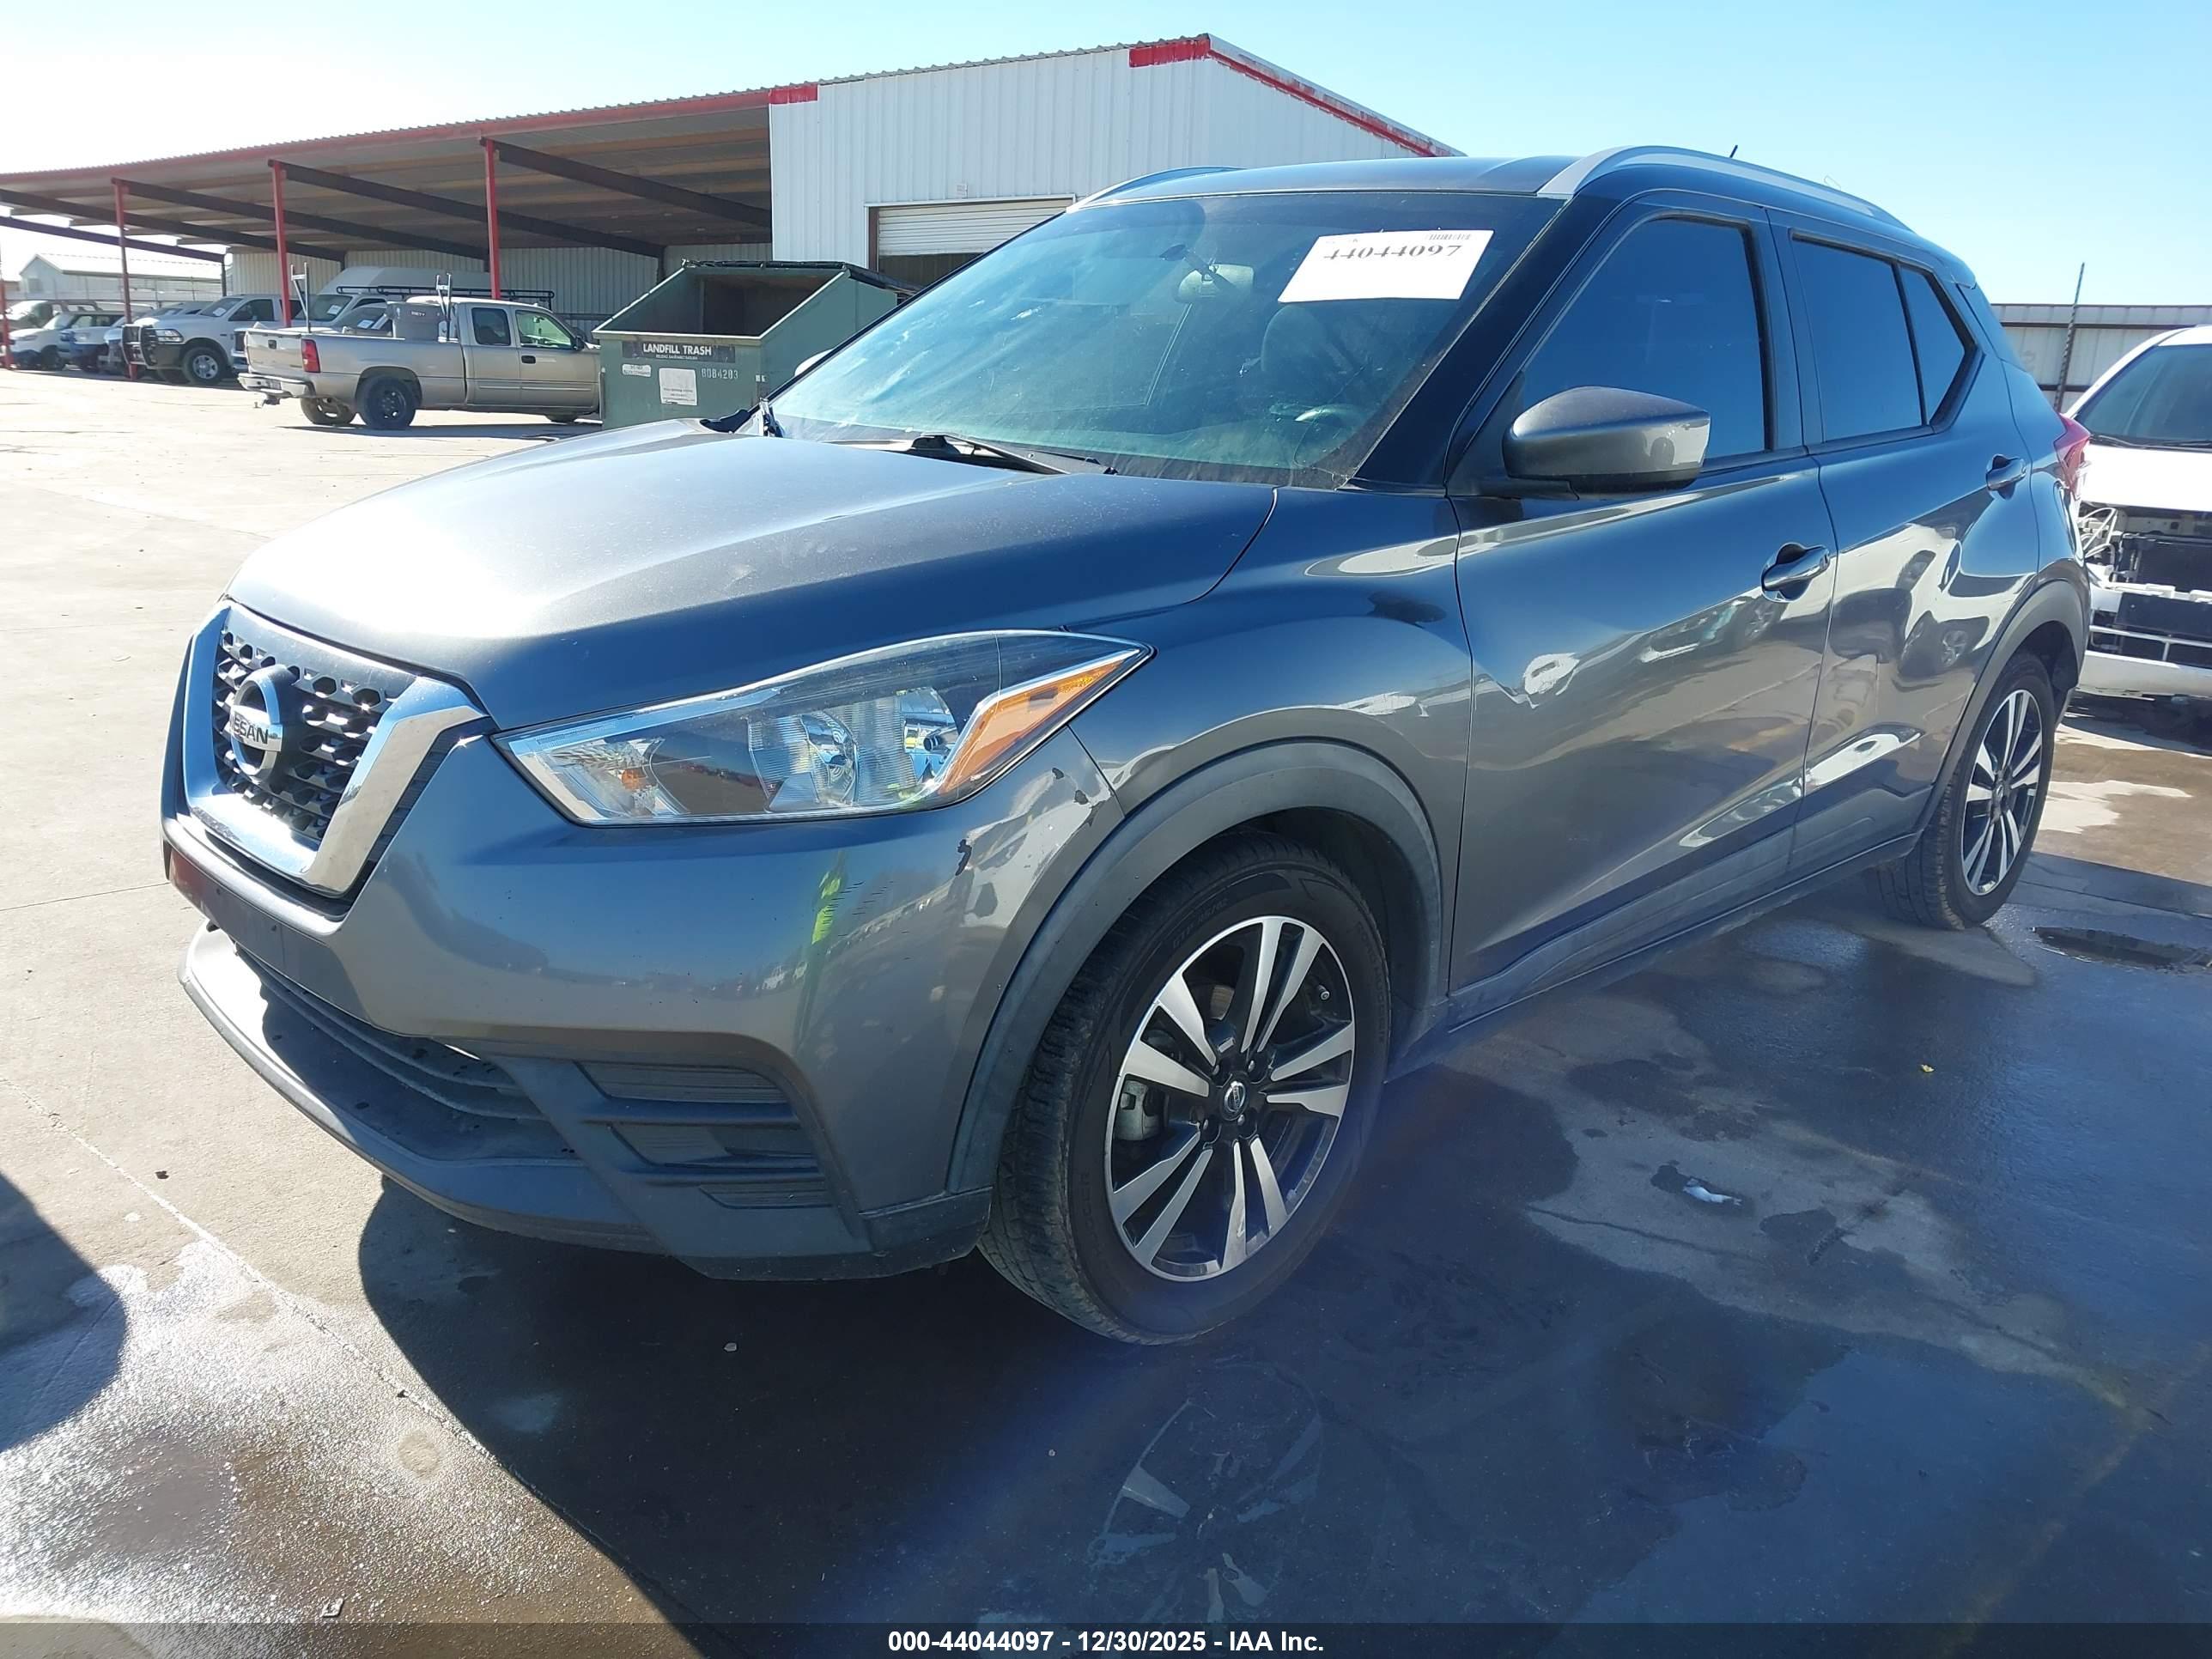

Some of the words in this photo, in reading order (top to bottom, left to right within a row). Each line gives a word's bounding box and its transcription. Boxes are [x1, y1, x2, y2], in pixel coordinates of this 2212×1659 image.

[1323, 244, 1463, 260] 44044097
[642, 343, 681, 355] LANDFILL
[682, 344, 712, 356] TRASH
